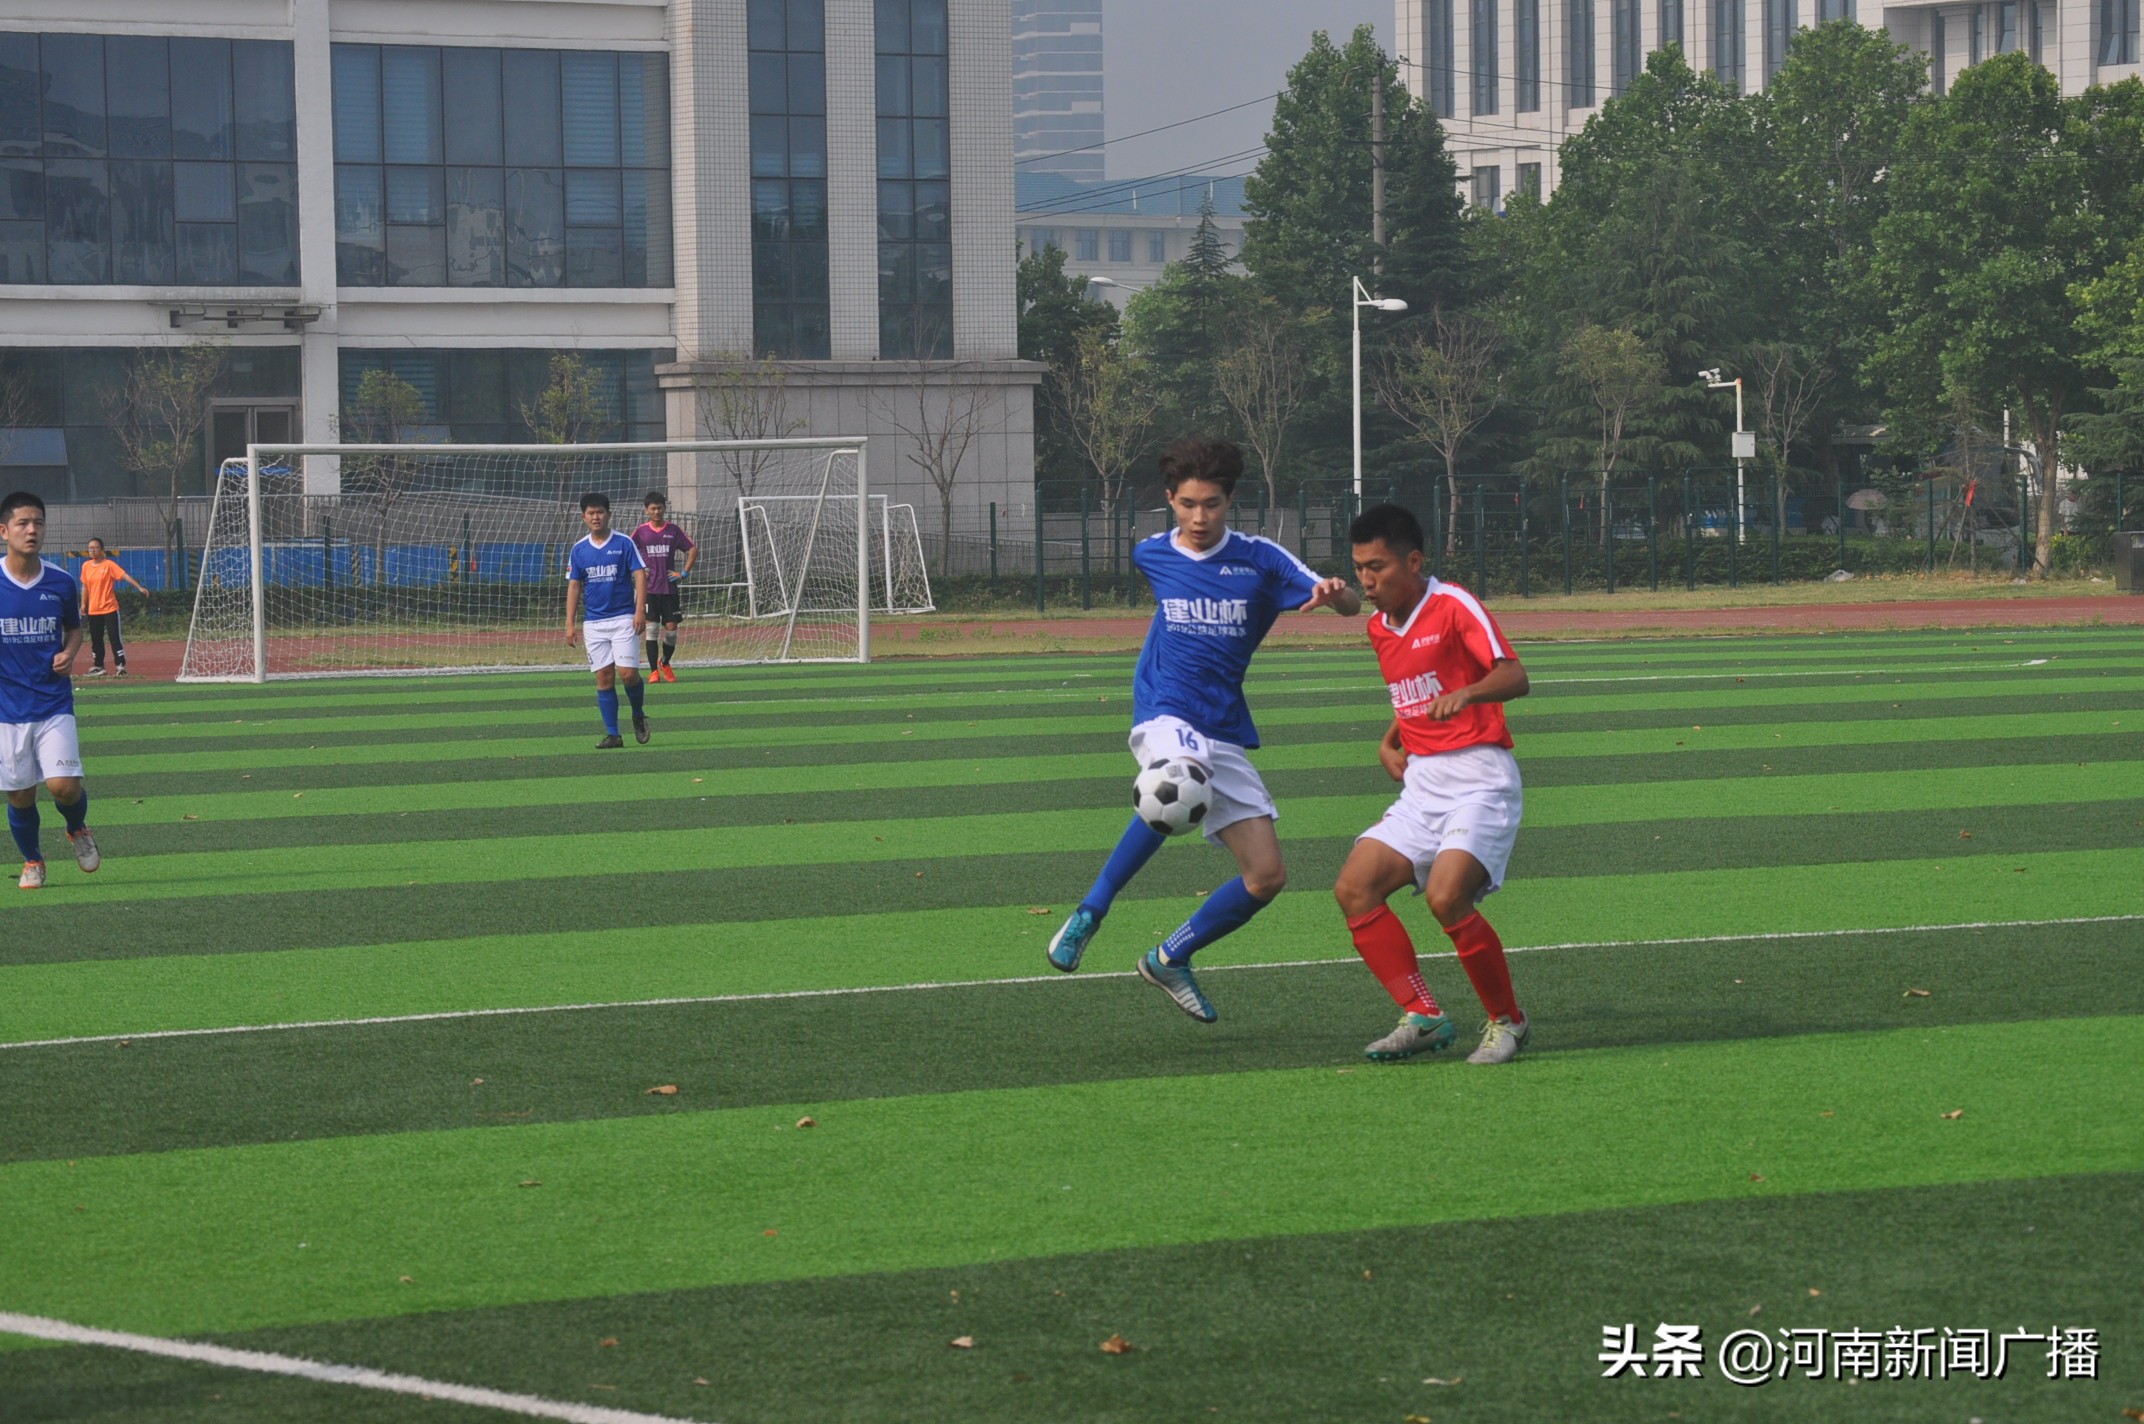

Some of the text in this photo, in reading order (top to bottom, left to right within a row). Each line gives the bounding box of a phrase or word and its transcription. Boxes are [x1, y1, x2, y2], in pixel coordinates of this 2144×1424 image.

[1162, 598, 1247, 625] 建业杯
[0, 617, 57, 635] 建业杯
[1388, 671, 1443, 709] 建业杯
[1175, 728, 1199, 751] 16
